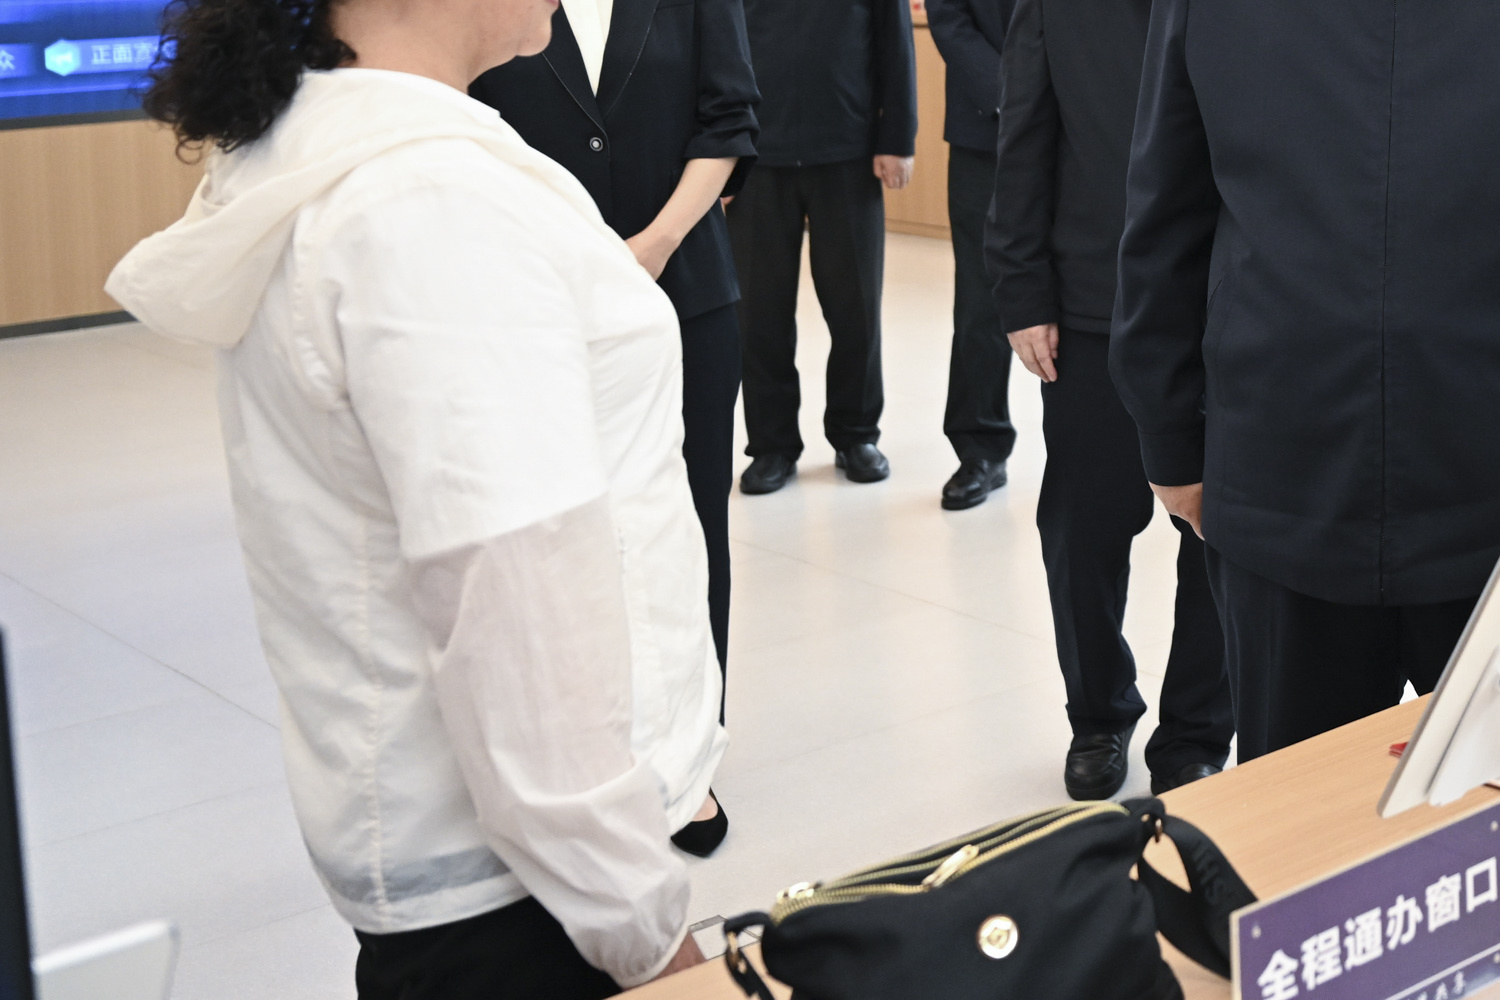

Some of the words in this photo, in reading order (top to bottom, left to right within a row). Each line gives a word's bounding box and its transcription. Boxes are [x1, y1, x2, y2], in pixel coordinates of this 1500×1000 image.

[1256, 855, 1499, 1000] 全程通办窗口
